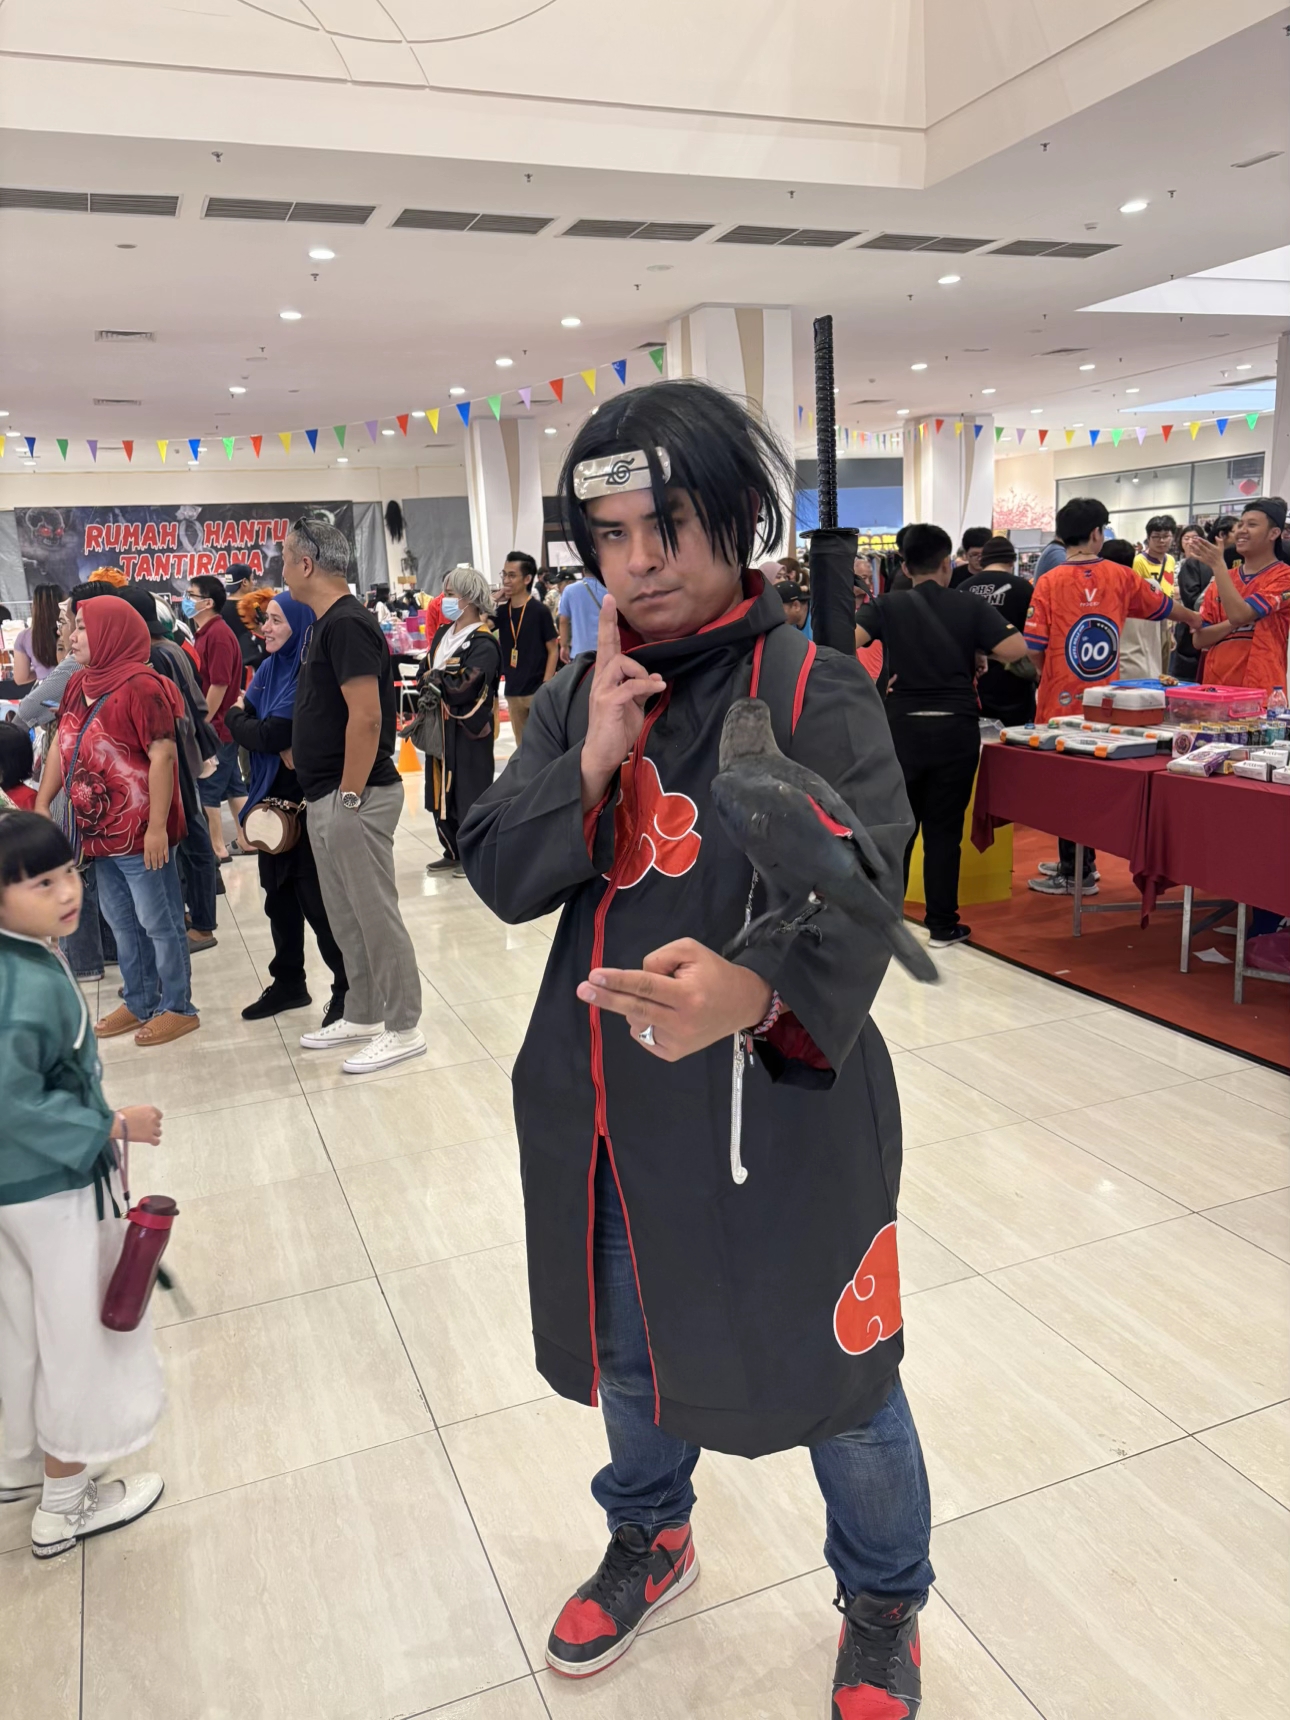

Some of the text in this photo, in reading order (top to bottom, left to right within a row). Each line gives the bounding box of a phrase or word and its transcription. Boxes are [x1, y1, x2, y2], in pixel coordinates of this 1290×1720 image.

[85, 518, 289, 555] RUMAH HANTU
[1084, 588, 1098, 602] V
